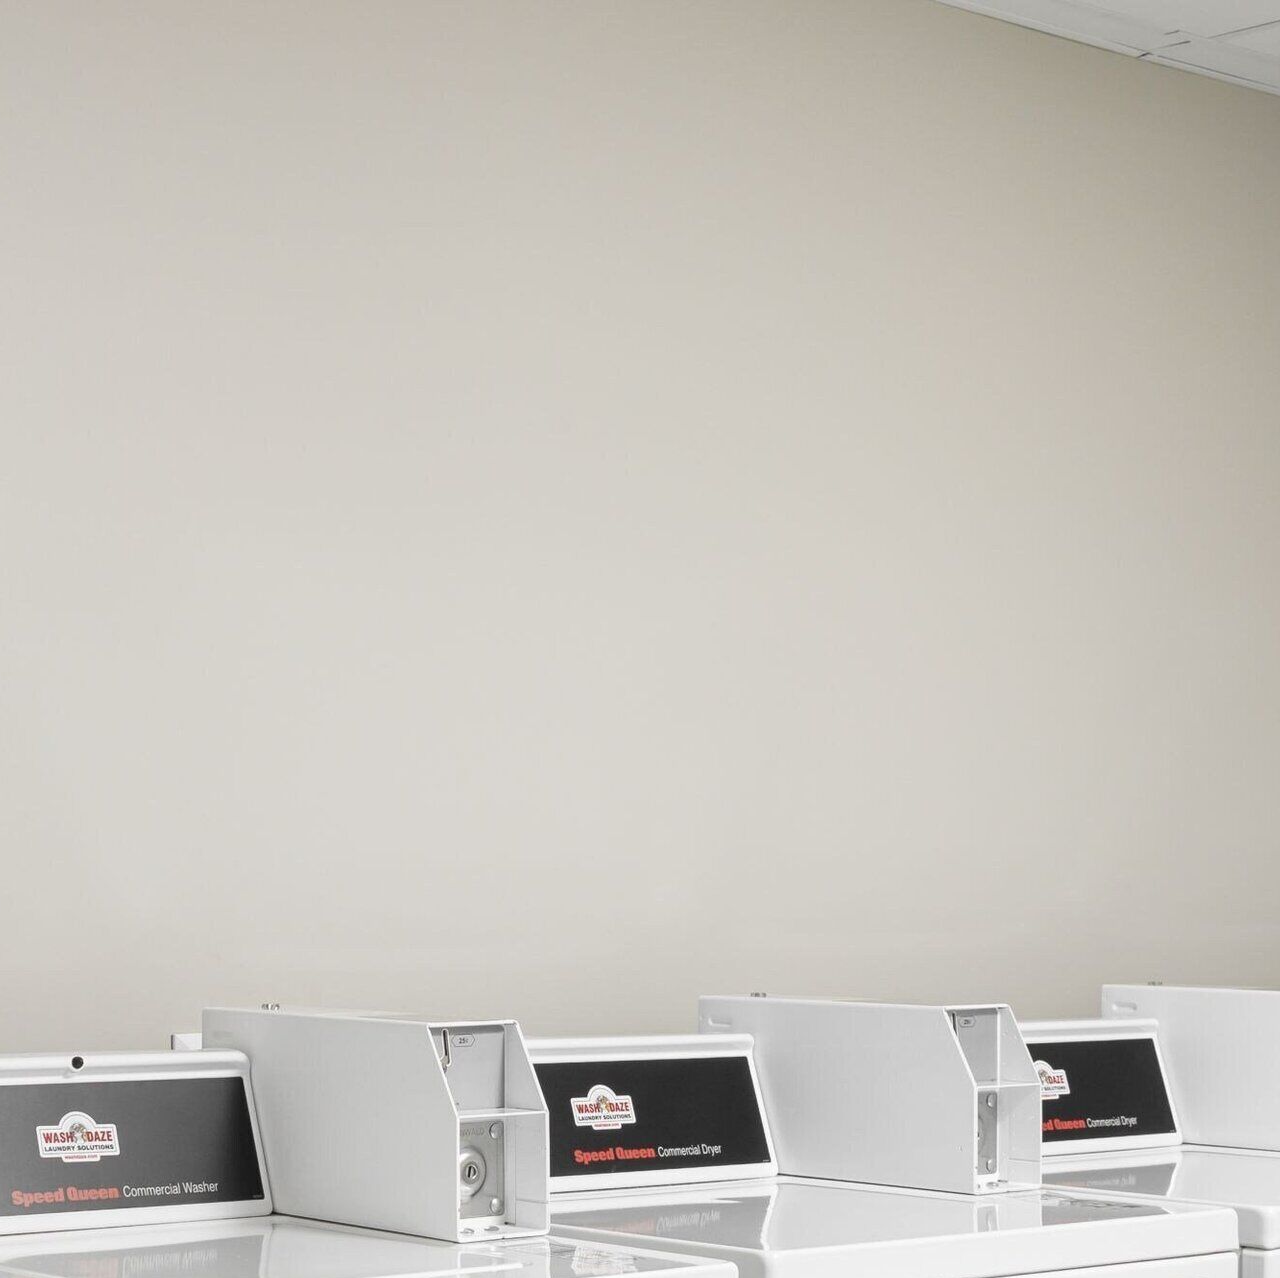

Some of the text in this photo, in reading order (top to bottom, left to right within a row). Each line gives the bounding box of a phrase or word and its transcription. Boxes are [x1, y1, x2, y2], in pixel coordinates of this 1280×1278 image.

[1047, 1075, 1065, 1084] DAZE
[576, 1102, 630, 1114] WASH DAZE
[1054, 1116, 1086, 1130] Queen
[1086, 1116, 1121, 1128] Commercial
[1120, 1115, 1138, 1127] Dryer
[42, 1130, 113, 1144] WASH DAZE
[76, 1143, 115, 1151] SOLUTIONS
[574, 1143, 722, 1165] Speed Queen Commercial Dryer
[11, 1180, 219, 1207] Speed Queen Commercial Washer
